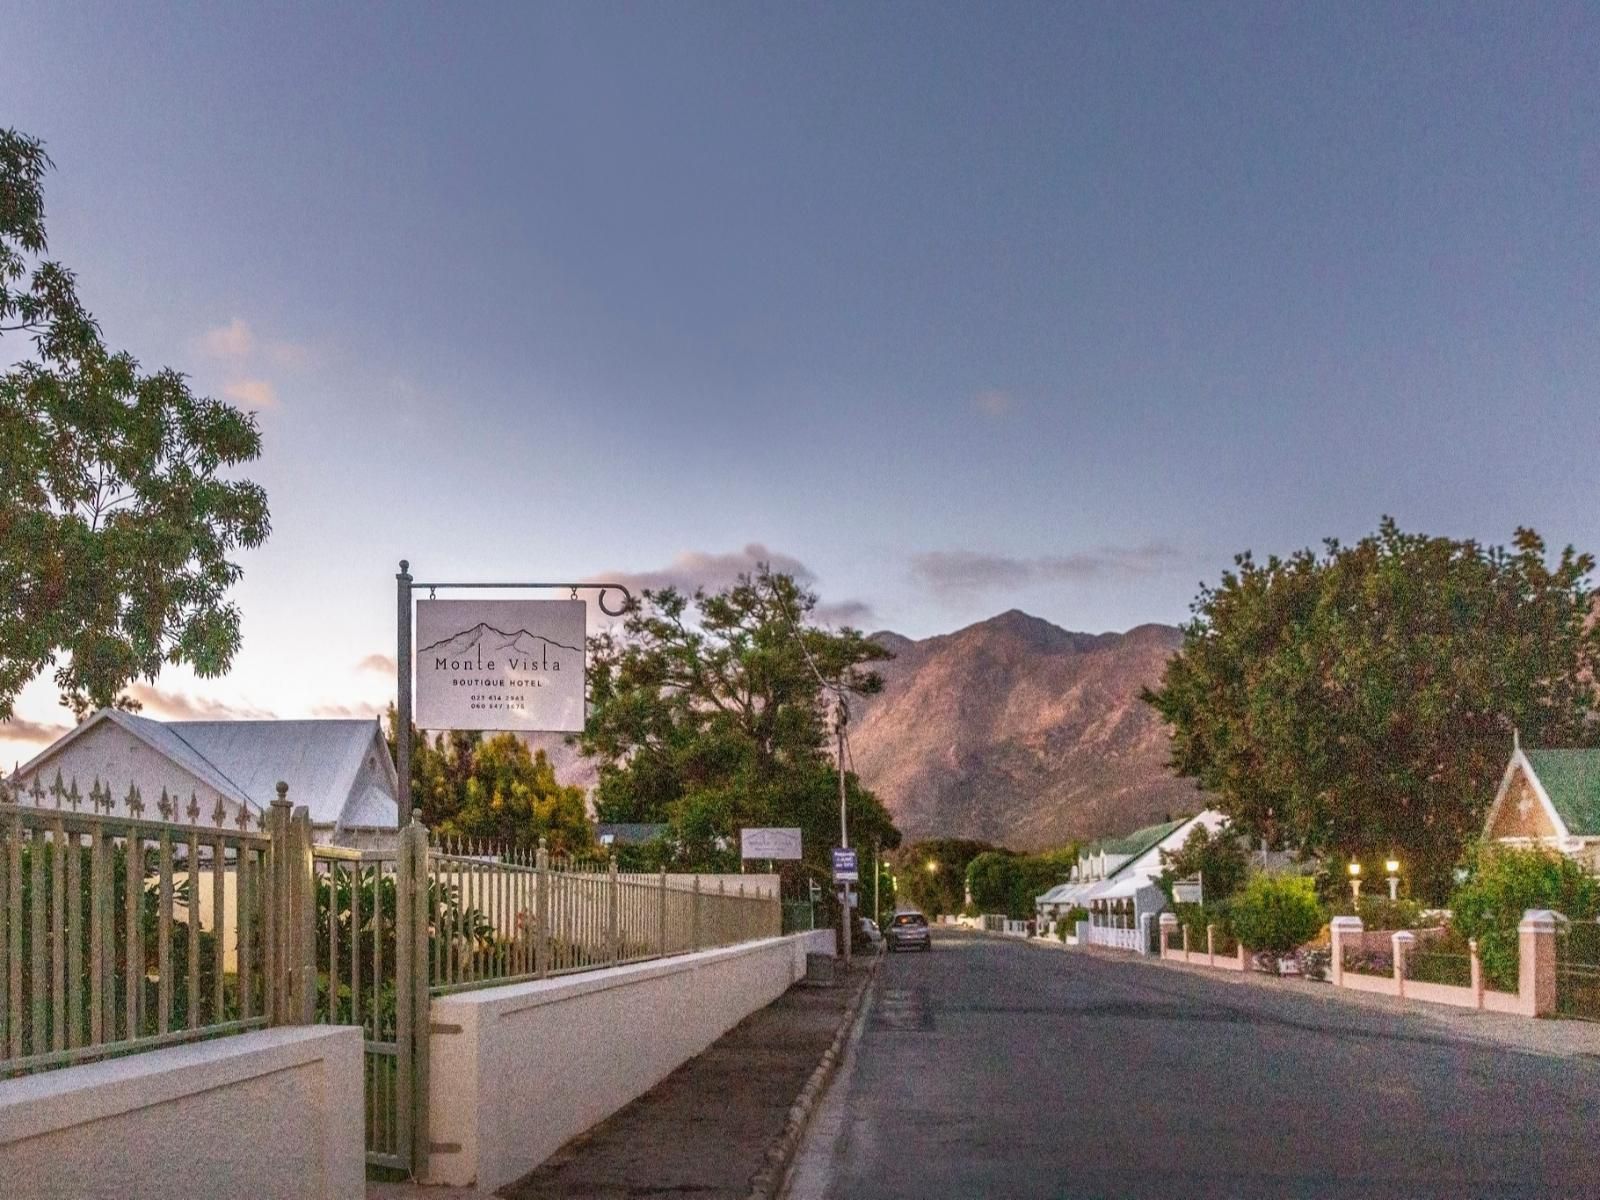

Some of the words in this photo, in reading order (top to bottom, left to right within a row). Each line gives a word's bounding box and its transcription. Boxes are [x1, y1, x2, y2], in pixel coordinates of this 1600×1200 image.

[435, 643, 495, 670] Monte
[509, 643, 561, 671] Vista
[453, 679, 505, 687] BOUTIQUE
[510, 679, 542, 687] HOTEL
